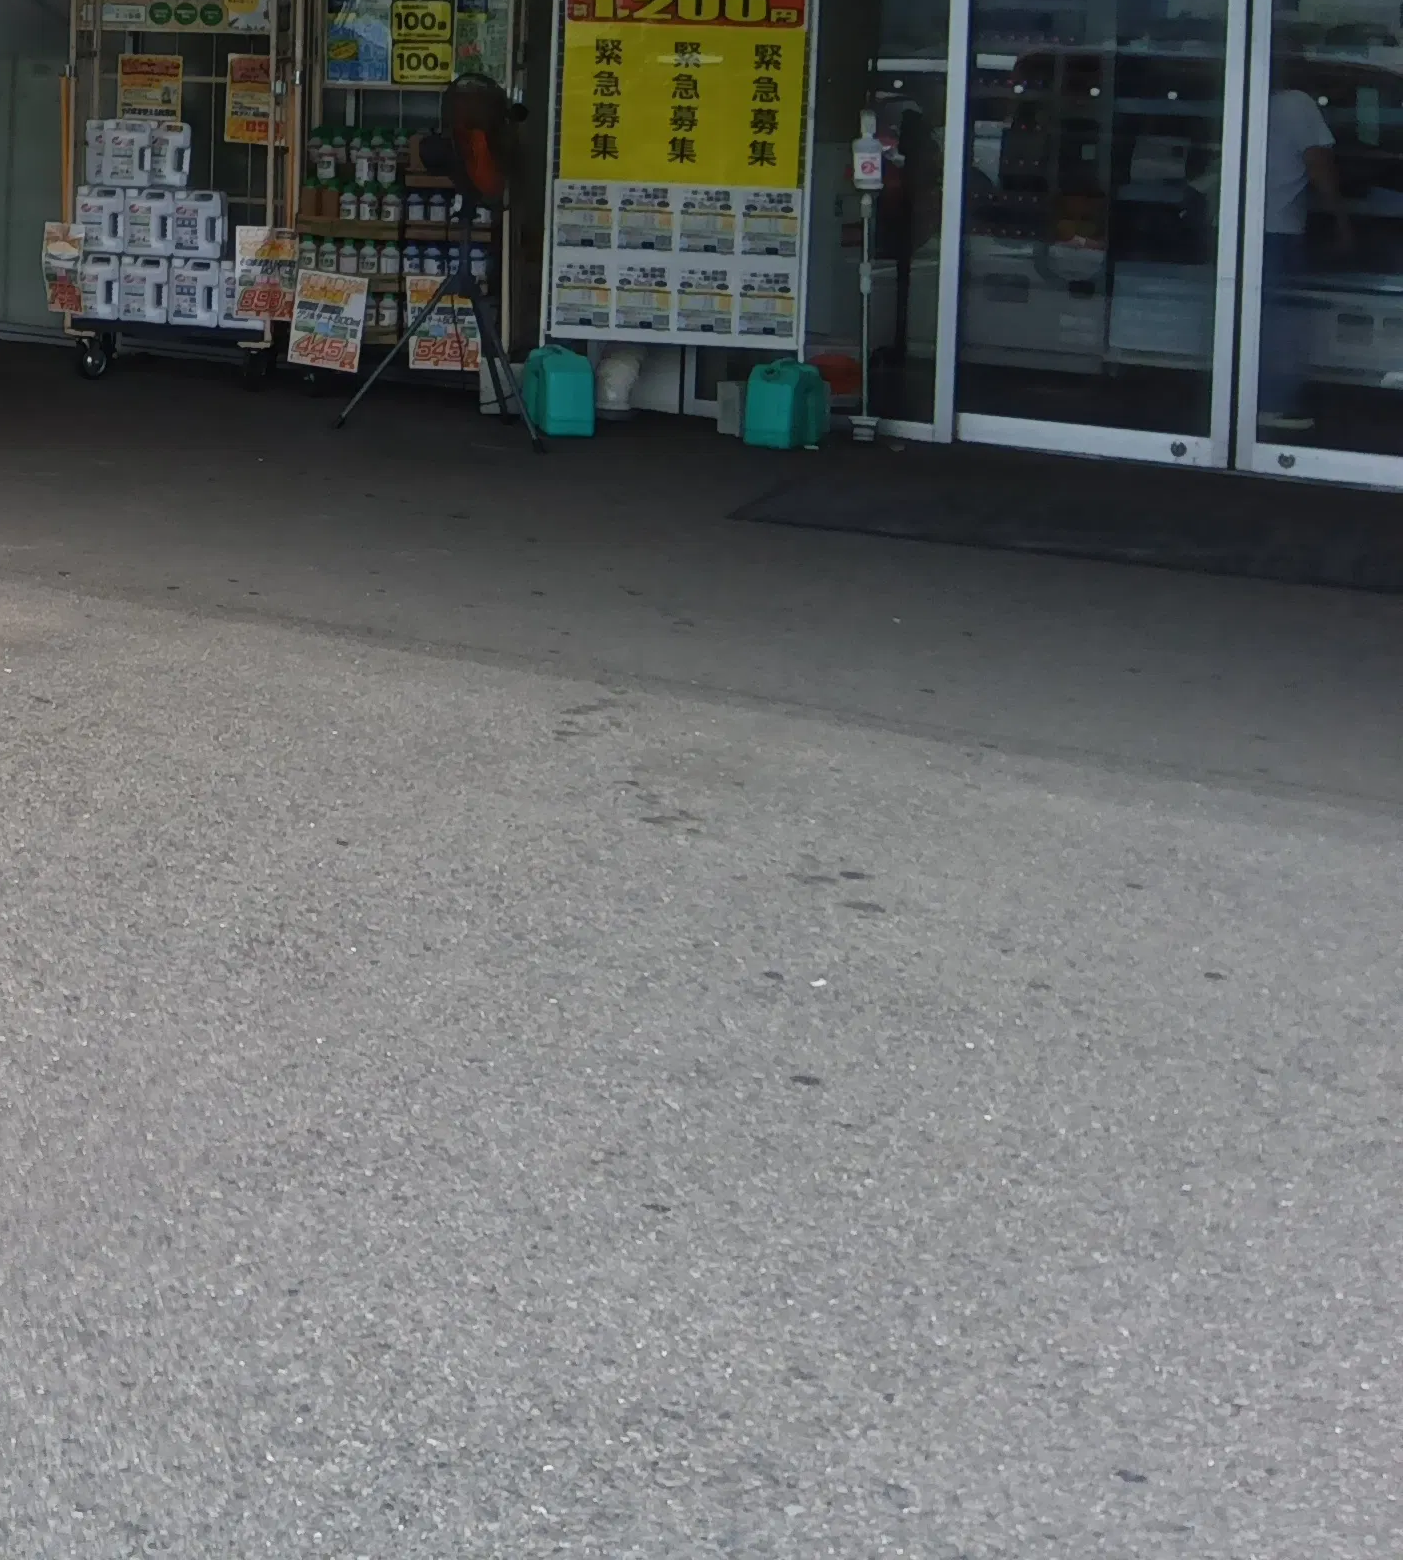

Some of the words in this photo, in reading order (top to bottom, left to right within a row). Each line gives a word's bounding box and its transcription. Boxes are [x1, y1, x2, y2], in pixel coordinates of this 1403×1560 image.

[590, 38, 623, 161] 緊急募集
[667, 41, 702, 164] 緊急募集
[747, 43, 783, 167] 緊急募集
[294, 333, 346, 361] 445
